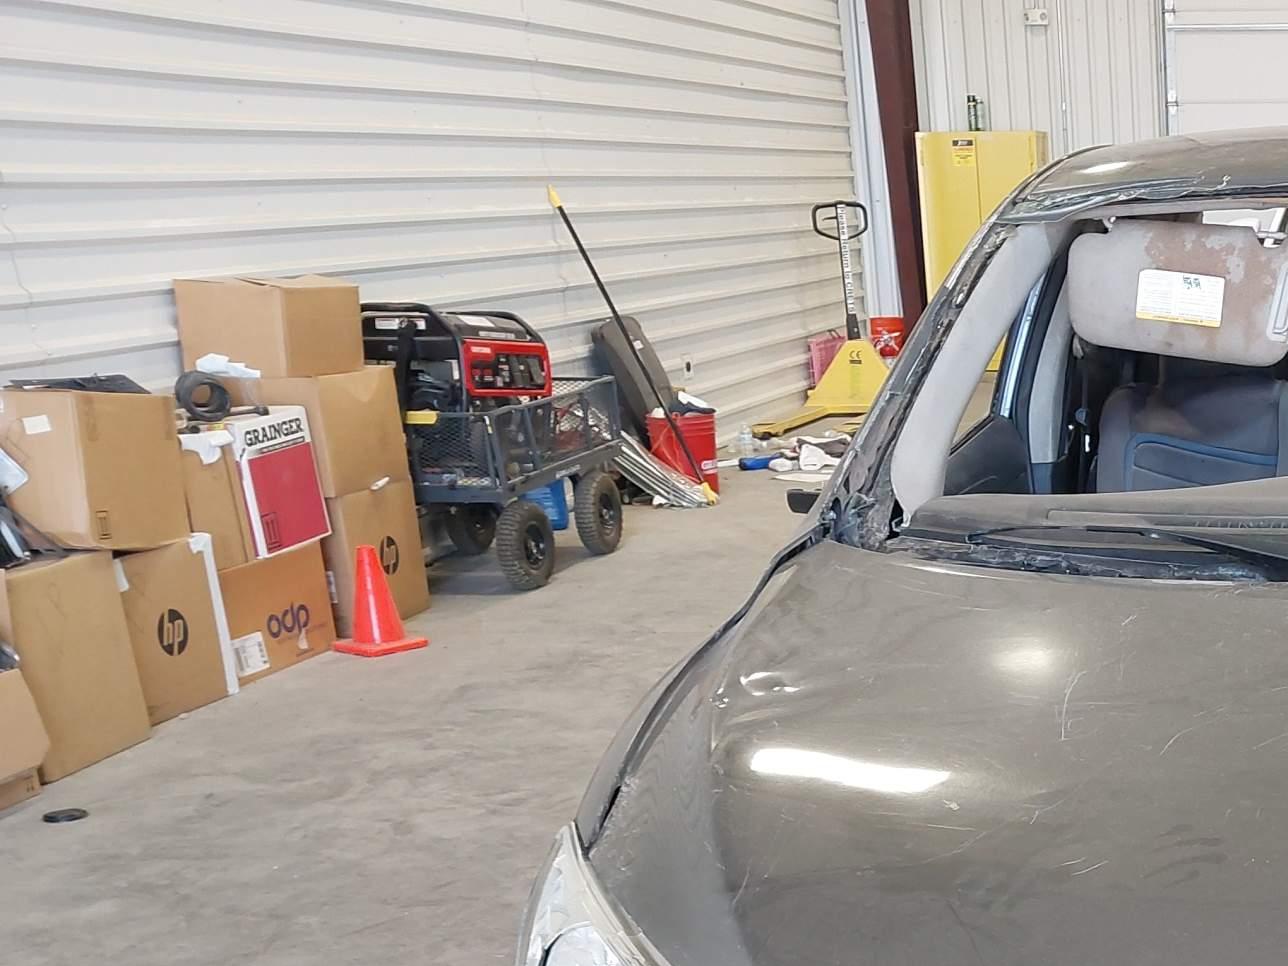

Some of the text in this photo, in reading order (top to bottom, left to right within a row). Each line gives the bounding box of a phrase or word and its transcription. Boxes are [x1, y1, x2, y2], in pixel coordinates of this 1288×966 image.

[837, 206, 846, 236] Please
[244, 417, 304, 447] GRAINGER
[267, 602, 310, 639] odp
